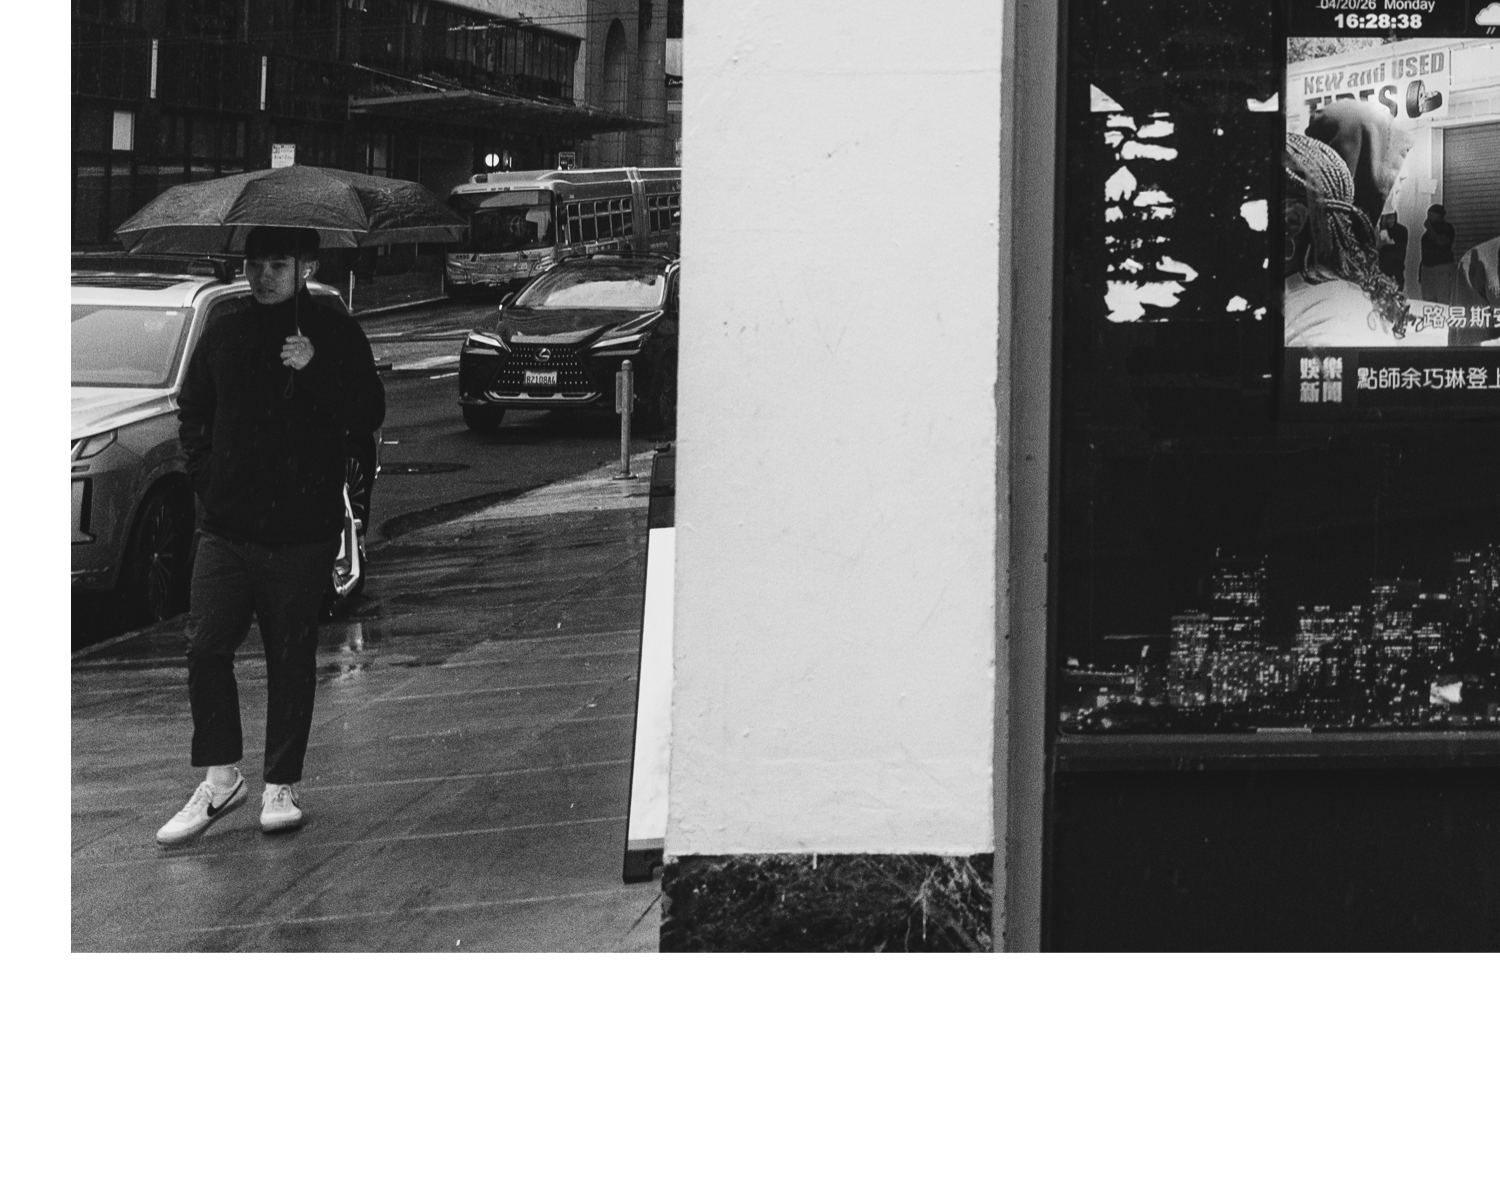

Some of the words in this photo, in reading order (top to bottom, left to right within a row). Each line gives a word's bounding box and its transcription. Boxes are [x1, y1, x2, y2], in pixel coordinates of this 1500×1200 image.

[1334, 13, 1423, 29] 16:28:38
[1304, 71, 1344, 95] NEW
[1391, 52, 1446, 81] USED
